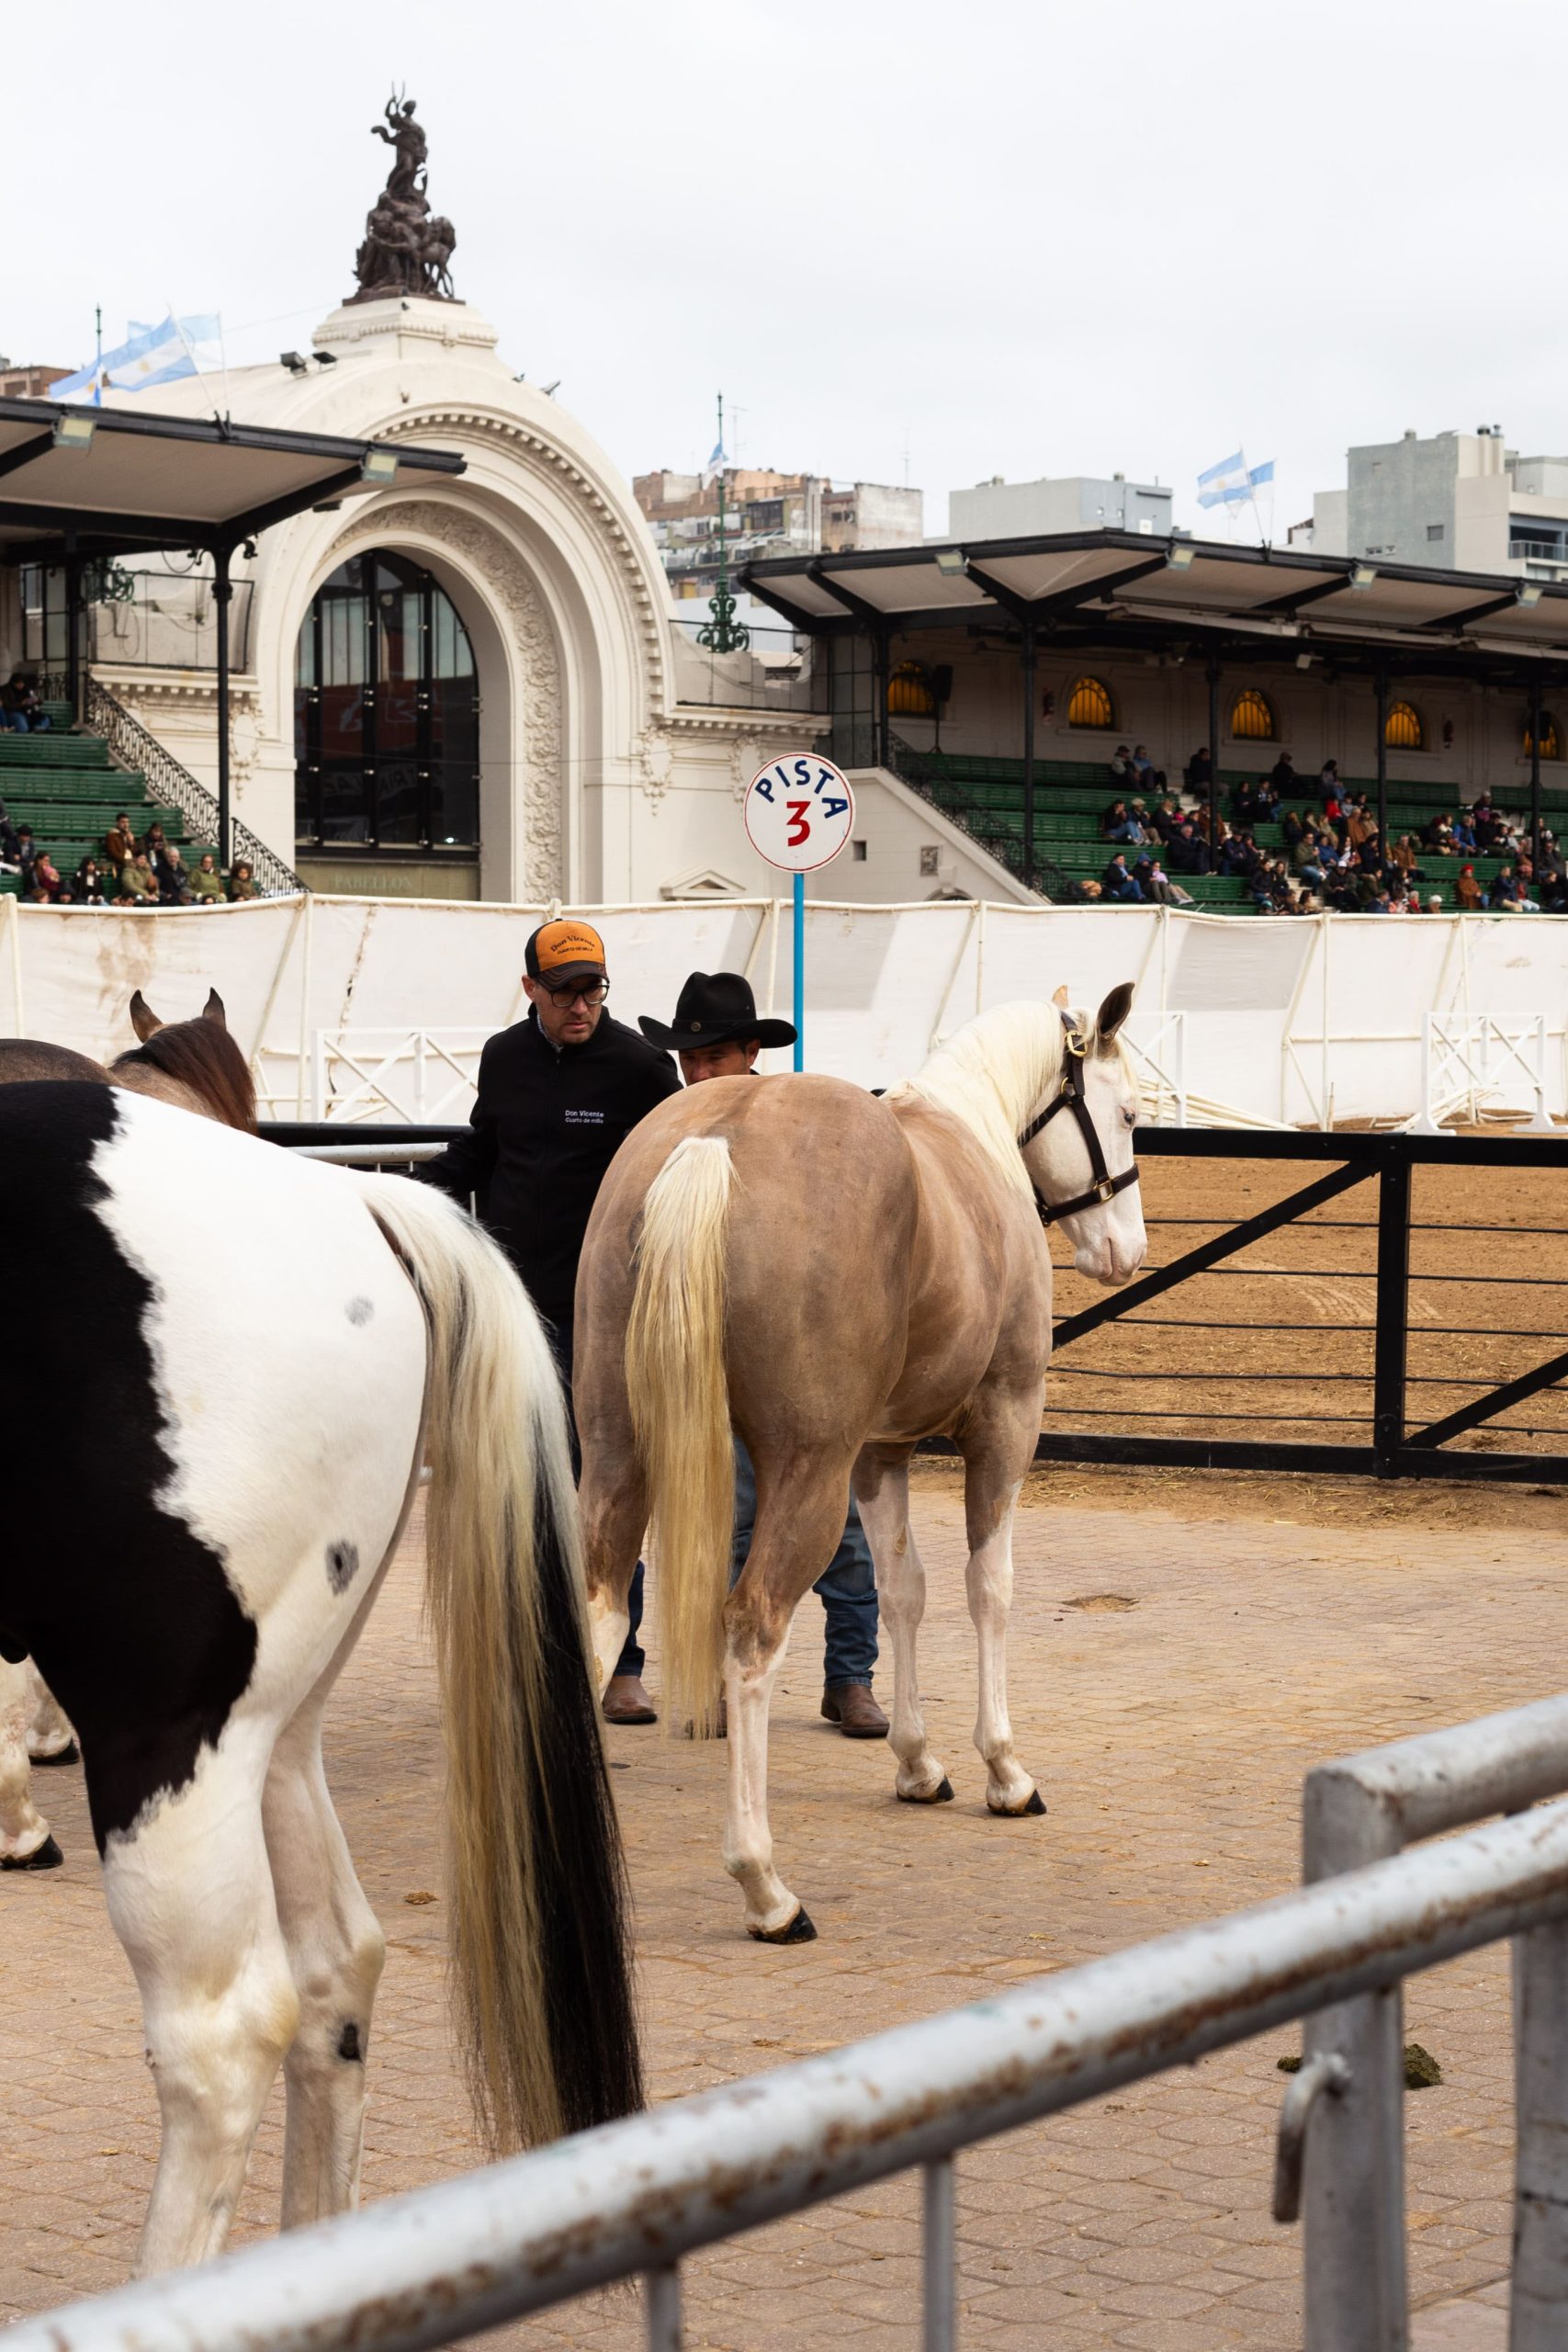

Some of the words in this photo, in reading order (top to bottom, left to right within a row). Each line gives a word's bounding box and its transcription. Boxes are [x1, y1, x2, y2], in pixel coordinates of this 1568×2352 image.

[754, 760, 849, 820] PISTA
[786, 801, 811, 847] 3
[550, 939, 566, 952] Don
[579, 1110, 604, 1118] Vicente
